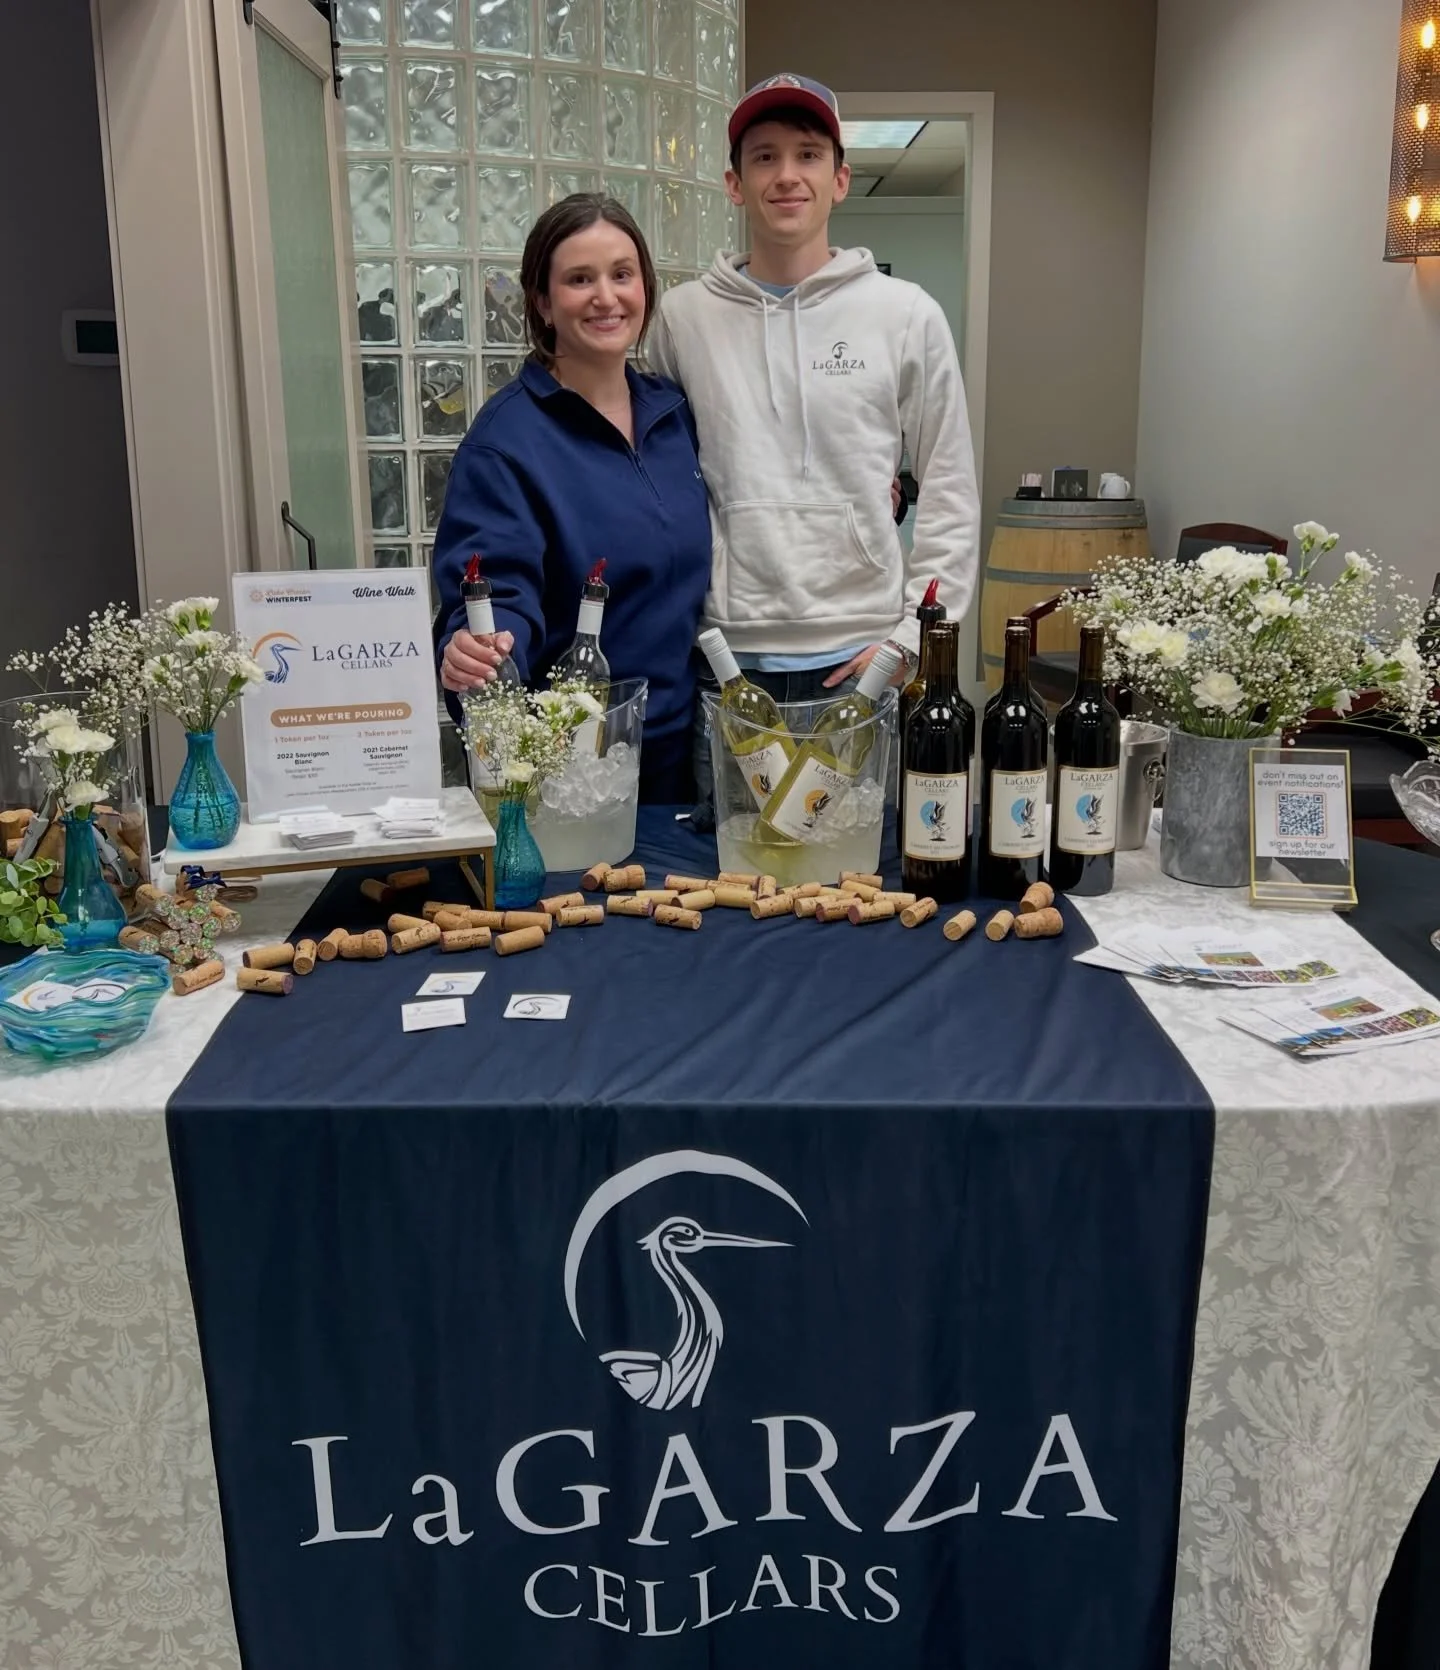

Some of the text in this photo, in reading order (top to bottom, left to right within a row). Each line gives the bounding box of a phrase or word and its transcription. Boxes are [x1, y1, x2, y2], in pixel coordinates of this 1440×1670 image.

[812, 360, 866, 370] LaGARZA
[352, 586, 416, 598] Wine Walk
[312, 641, 420, 661] LaGARZA
[341, 660, 393, 670] CELLARS
[280, 708, 404, 724] WHAT WE'RE POURING
[1005, 775, 1045, 785] LaGARZA
[1071, 772, 1113, 782] LaGARZA
[1263, 771, 1285, 779] don't
[915, 778, 958, 788] LaGARZA
[1285, 780, 1344, 788] notifications!
[1269, 841, 1288, 849] sign
[1304, 840, 1317, 848] for
[291, 1410, 1119, 1547] LaGARZA
[523, 1554, 902, 1637] CELLARS
